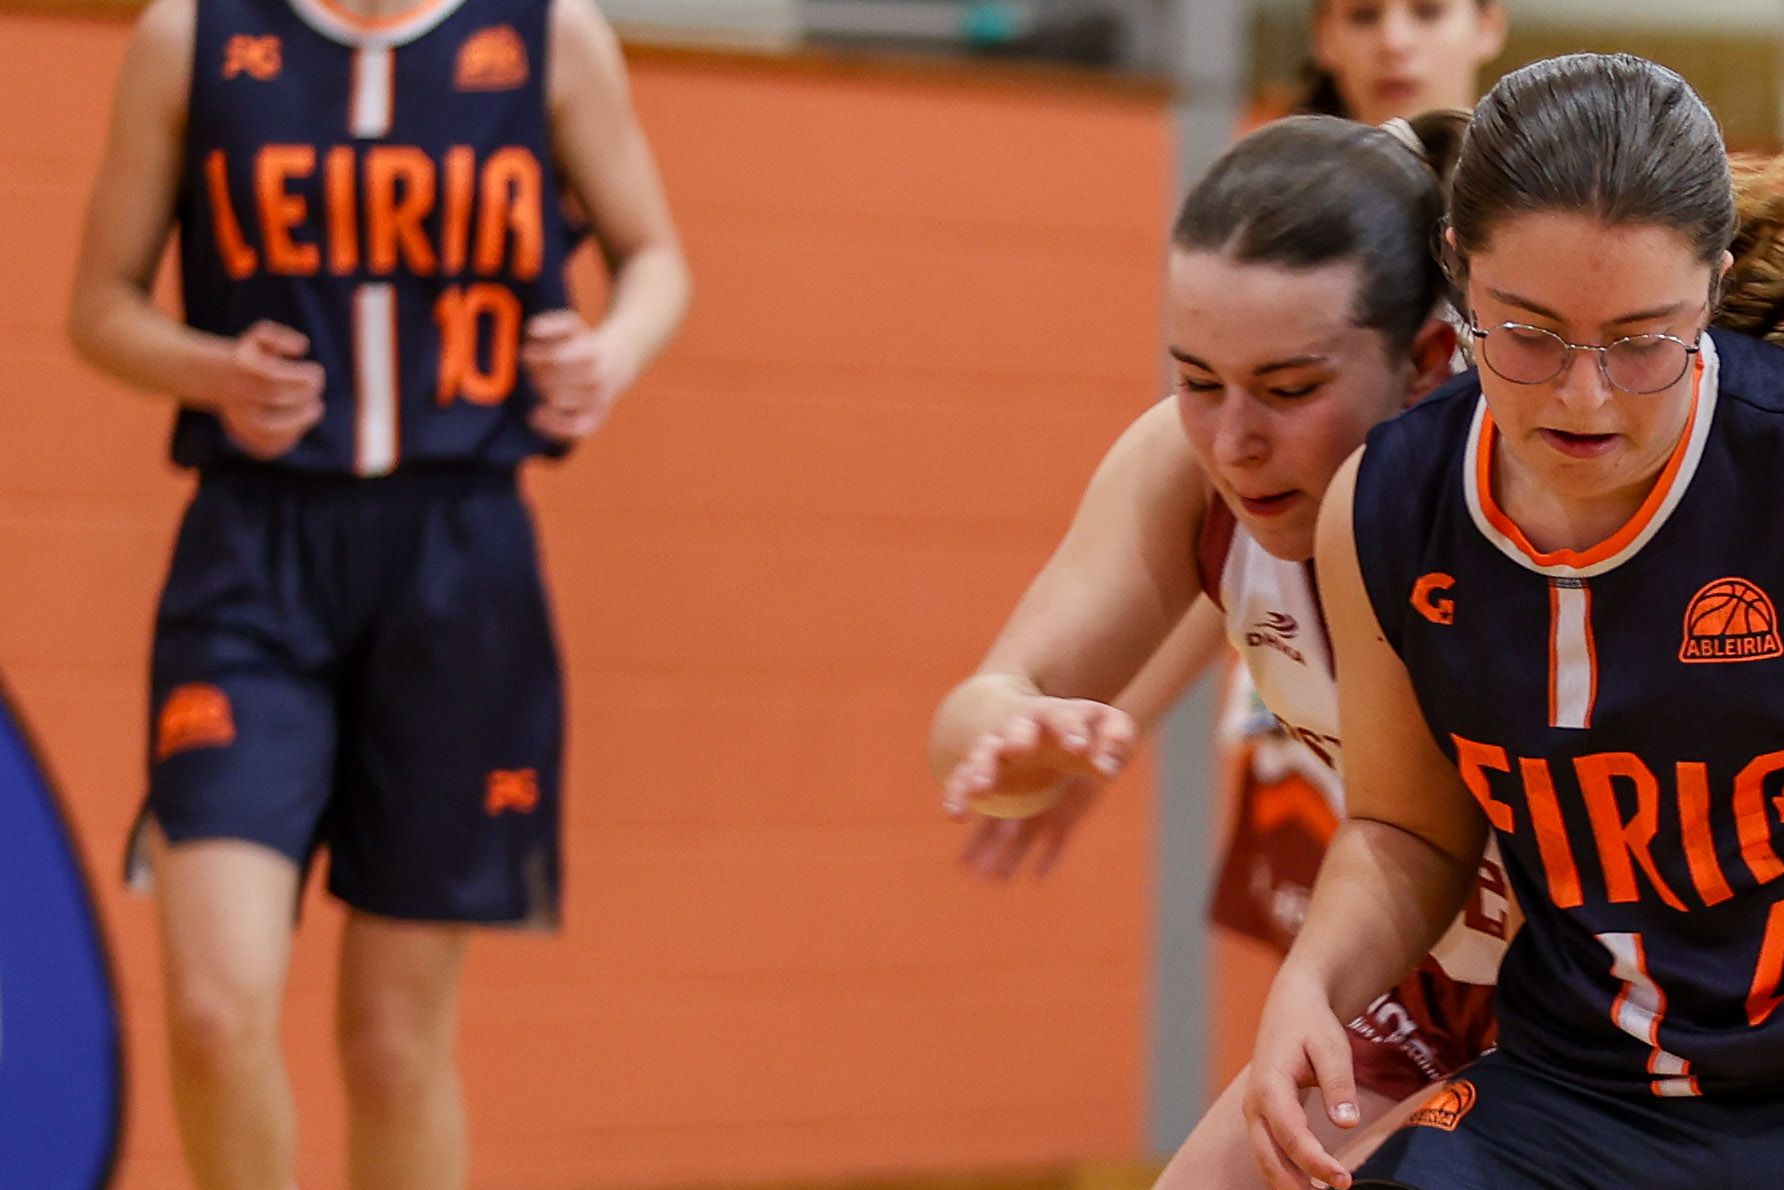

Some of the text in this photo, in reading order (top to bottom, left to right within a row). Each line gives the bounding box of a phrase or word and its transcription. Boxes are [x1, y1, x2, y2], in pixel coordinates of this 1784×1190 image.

[205, 144, 543, 279] LEIRIA
[434, 284, 521, 404] 10
[1687, 635, 1776, 657] ABLEIRIA
